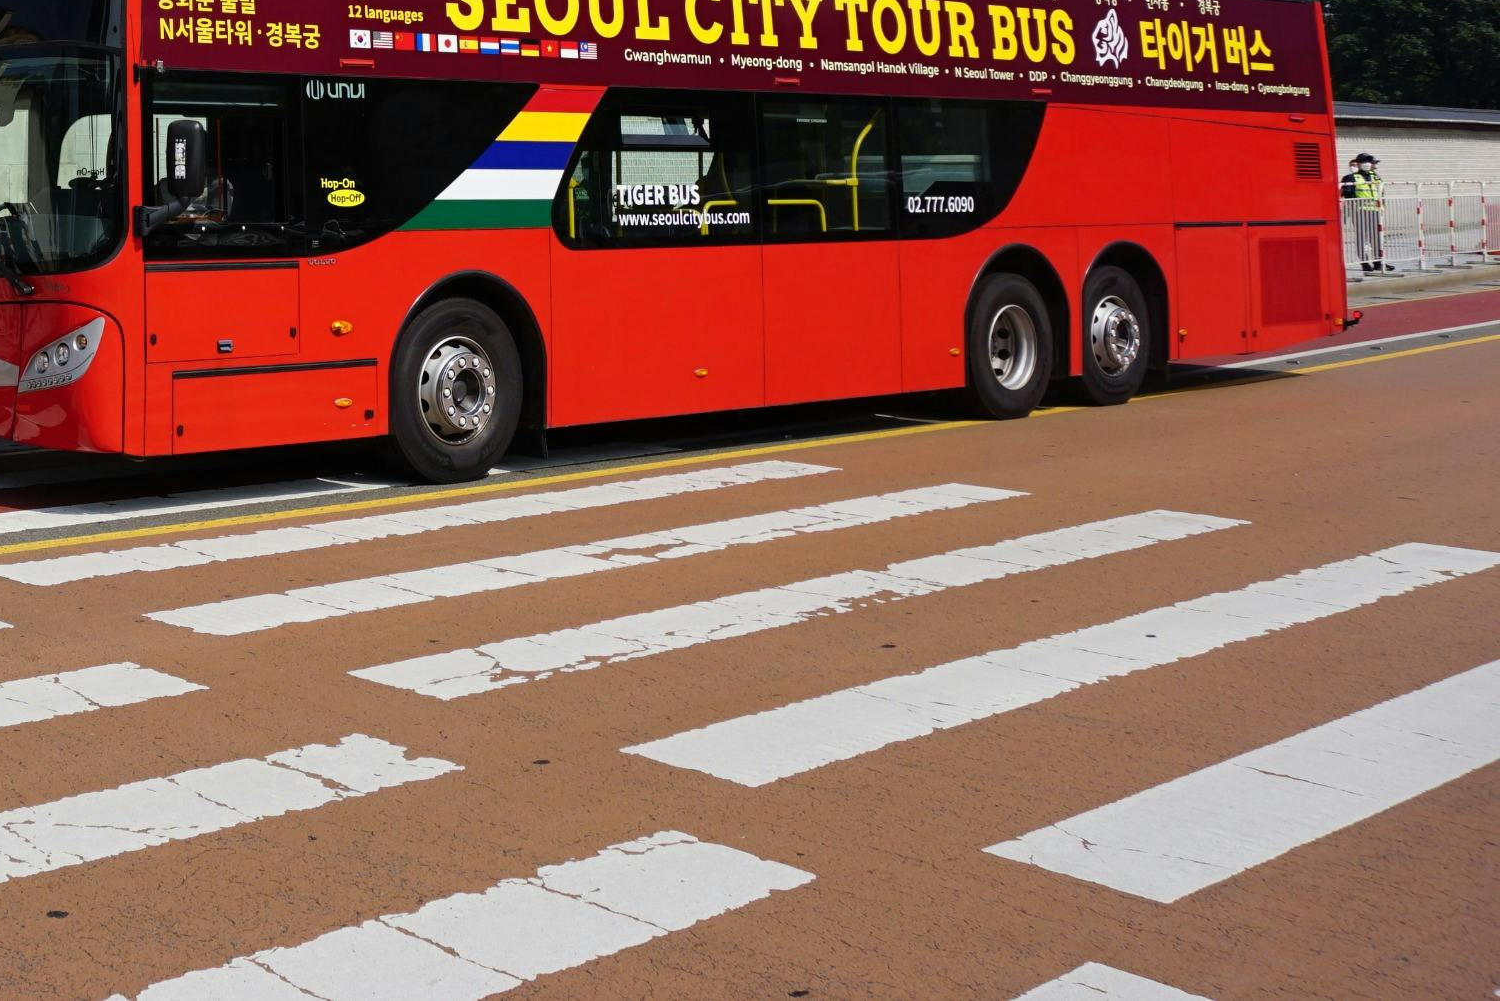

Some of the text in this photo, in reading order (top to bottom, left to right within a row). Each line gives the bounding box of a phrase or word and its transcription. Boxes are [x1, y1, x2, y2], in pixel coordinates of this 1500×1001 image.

[348, 4, 424, 25] 12 languages
[987, 4, 1076, 65] BUS
[1139, 18, 1275, 75] 타이거 버스
[624, 48, 1311, 96] Gwanghwamun Myeong-dong Namsangol Hanok Village N Seoul Tower DDP Changgyeonggung Changdeokgung Insa-dong Gyeongbokgung
[320, 177, 356, 190] Hop-On
[330, 193, 362, 204] Hop-Off
[616, 184, 700, 205] TIGER BUS
[907, 196, 975, 213] 02.777.6090
[618, 209, 751, 228] www.seoulcitybus.com
